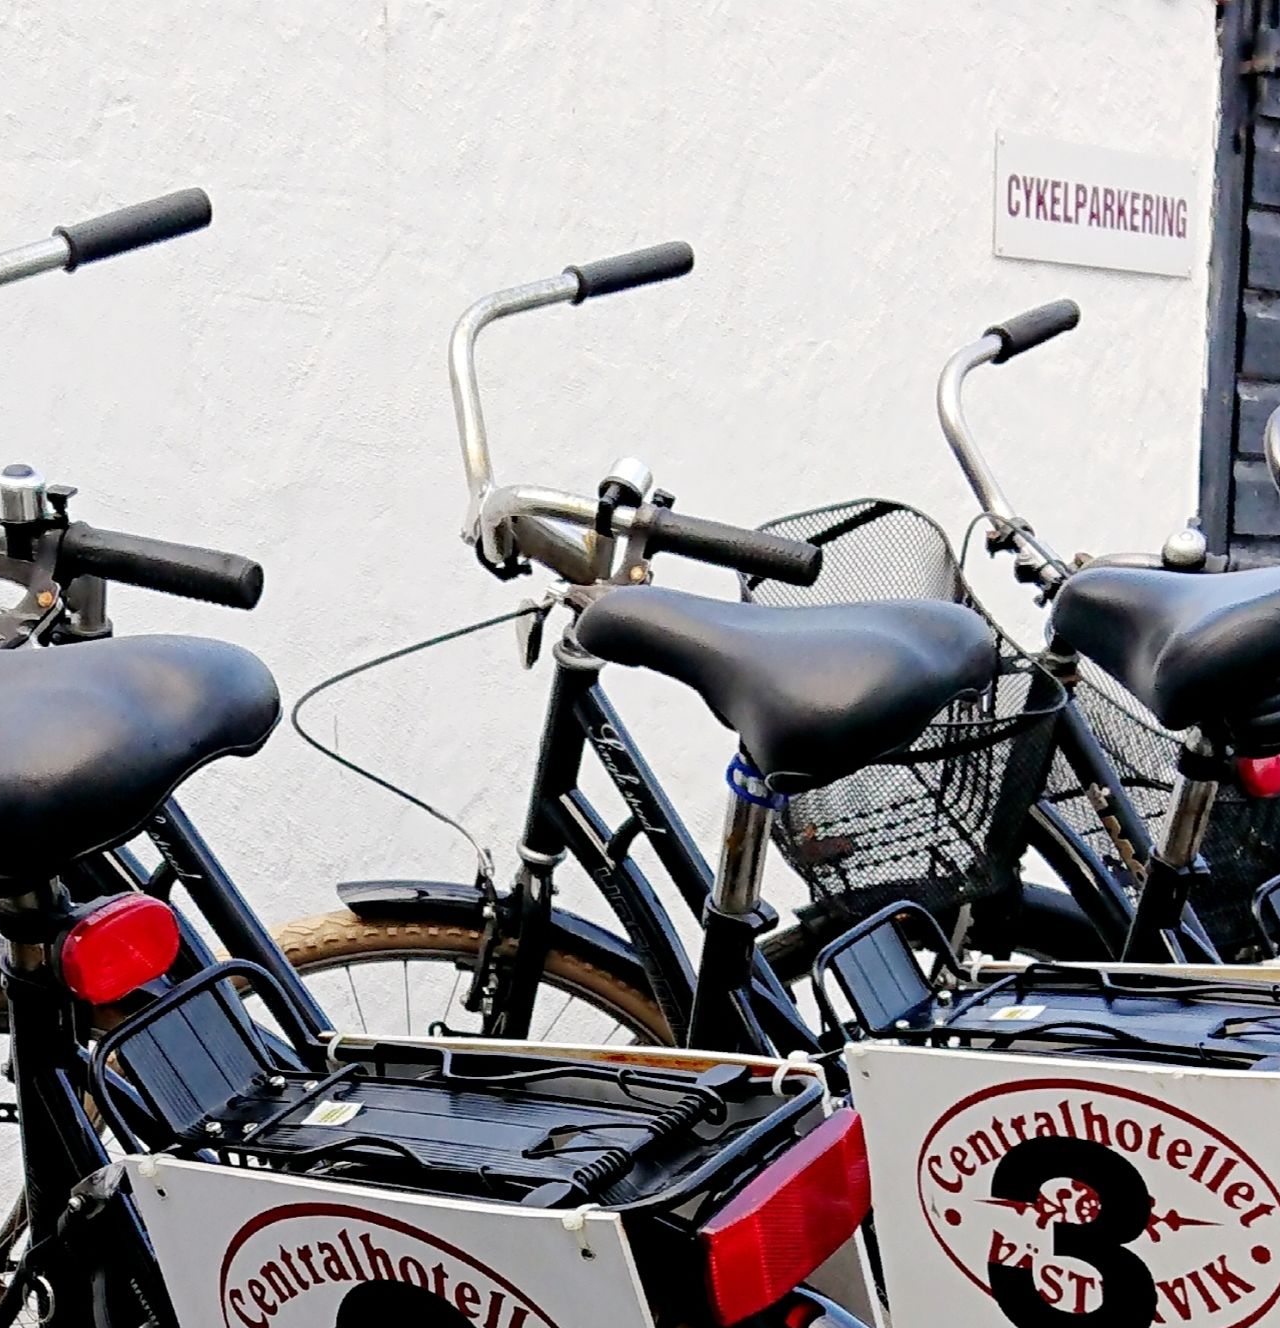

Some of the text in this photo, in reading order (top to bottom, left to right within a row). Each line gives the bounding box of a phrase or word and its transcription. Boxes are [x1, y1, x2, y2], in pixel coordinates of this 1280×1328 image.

[1007, 173, 1188, 239] CYKELPARKERING
[927, 1099, 1277, 1228] Centralhotellet
[988, 1229, 1256, 1324] VSTVIK
